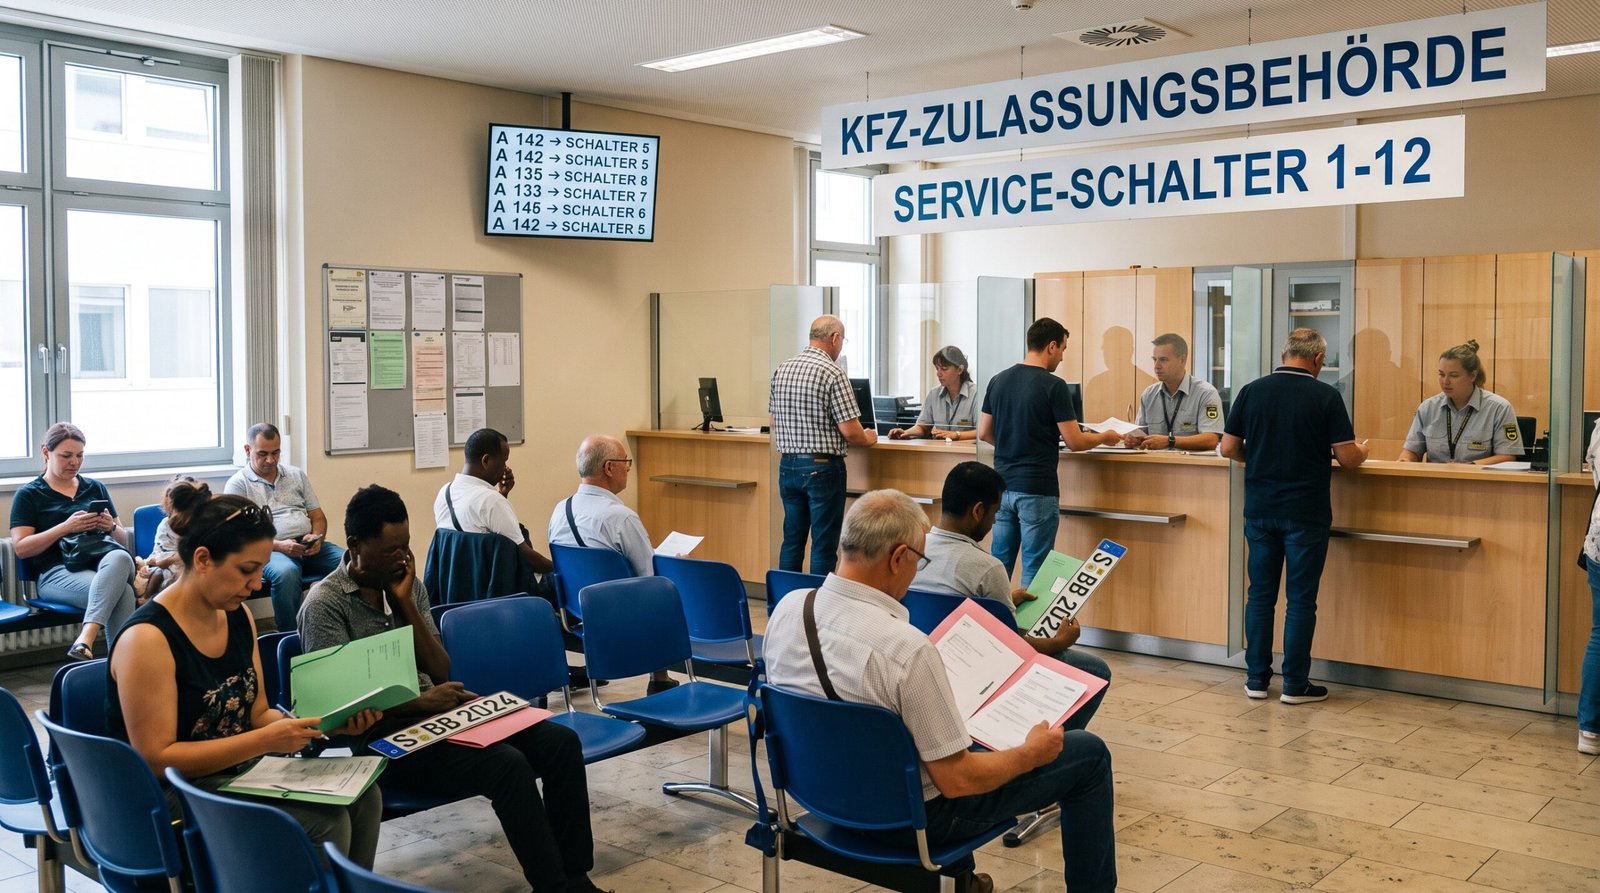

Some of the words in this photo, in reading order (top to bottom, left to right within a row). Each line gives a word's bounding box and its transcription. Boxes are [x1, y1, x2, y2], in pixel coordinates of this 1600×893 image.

[841, 26, 1507, 156] KFZ-ZULASSUNGSBEHÖRDE
[496, 131, 509, 145] A
[516, 132, 544, 147] 142
[566, 137, 638, 153] SCHALTER
[642, 143, 649, 154] 5
[495, 148, 508, 162] A
[515, 149, 543, 164] 142
[565, 154, 637, 169] SCHALTER
[641, 159, 649, 170] 5
[495, 165, 507, 179] A
[515, 166, 542, 181] 135
[564, 171, 636, 186] SCHALTER
[640, 175, 648, 186] 8
[893, 151, 1309, 223] SERVICE-SCHALTER
[1327, 136, 1431, 190] 1-12
[494, 182, 506, 196] A
[514, 183, 542, 198] 133
[563, 187, 635, 202] SCHALTER
[640, 192, 647, 202] 7
[493, 200, 506, 213] A
[563, 204, 634, 218] SCHALTER
[638, 208, 646, 219] 6
[492, 217, 505, 230] A
[512, 218, 540, 231] 142
[562, 221, 633, 234] SCHALTER
[638, 224, 645, 235] 5
[1093, 552, 1113, 567] S
[1068, 571, 1098, 597] BB
[392, 733, 418, 748] S
[420, 717, 461, 736] BB
[456, 694, 518, 722] 2024
